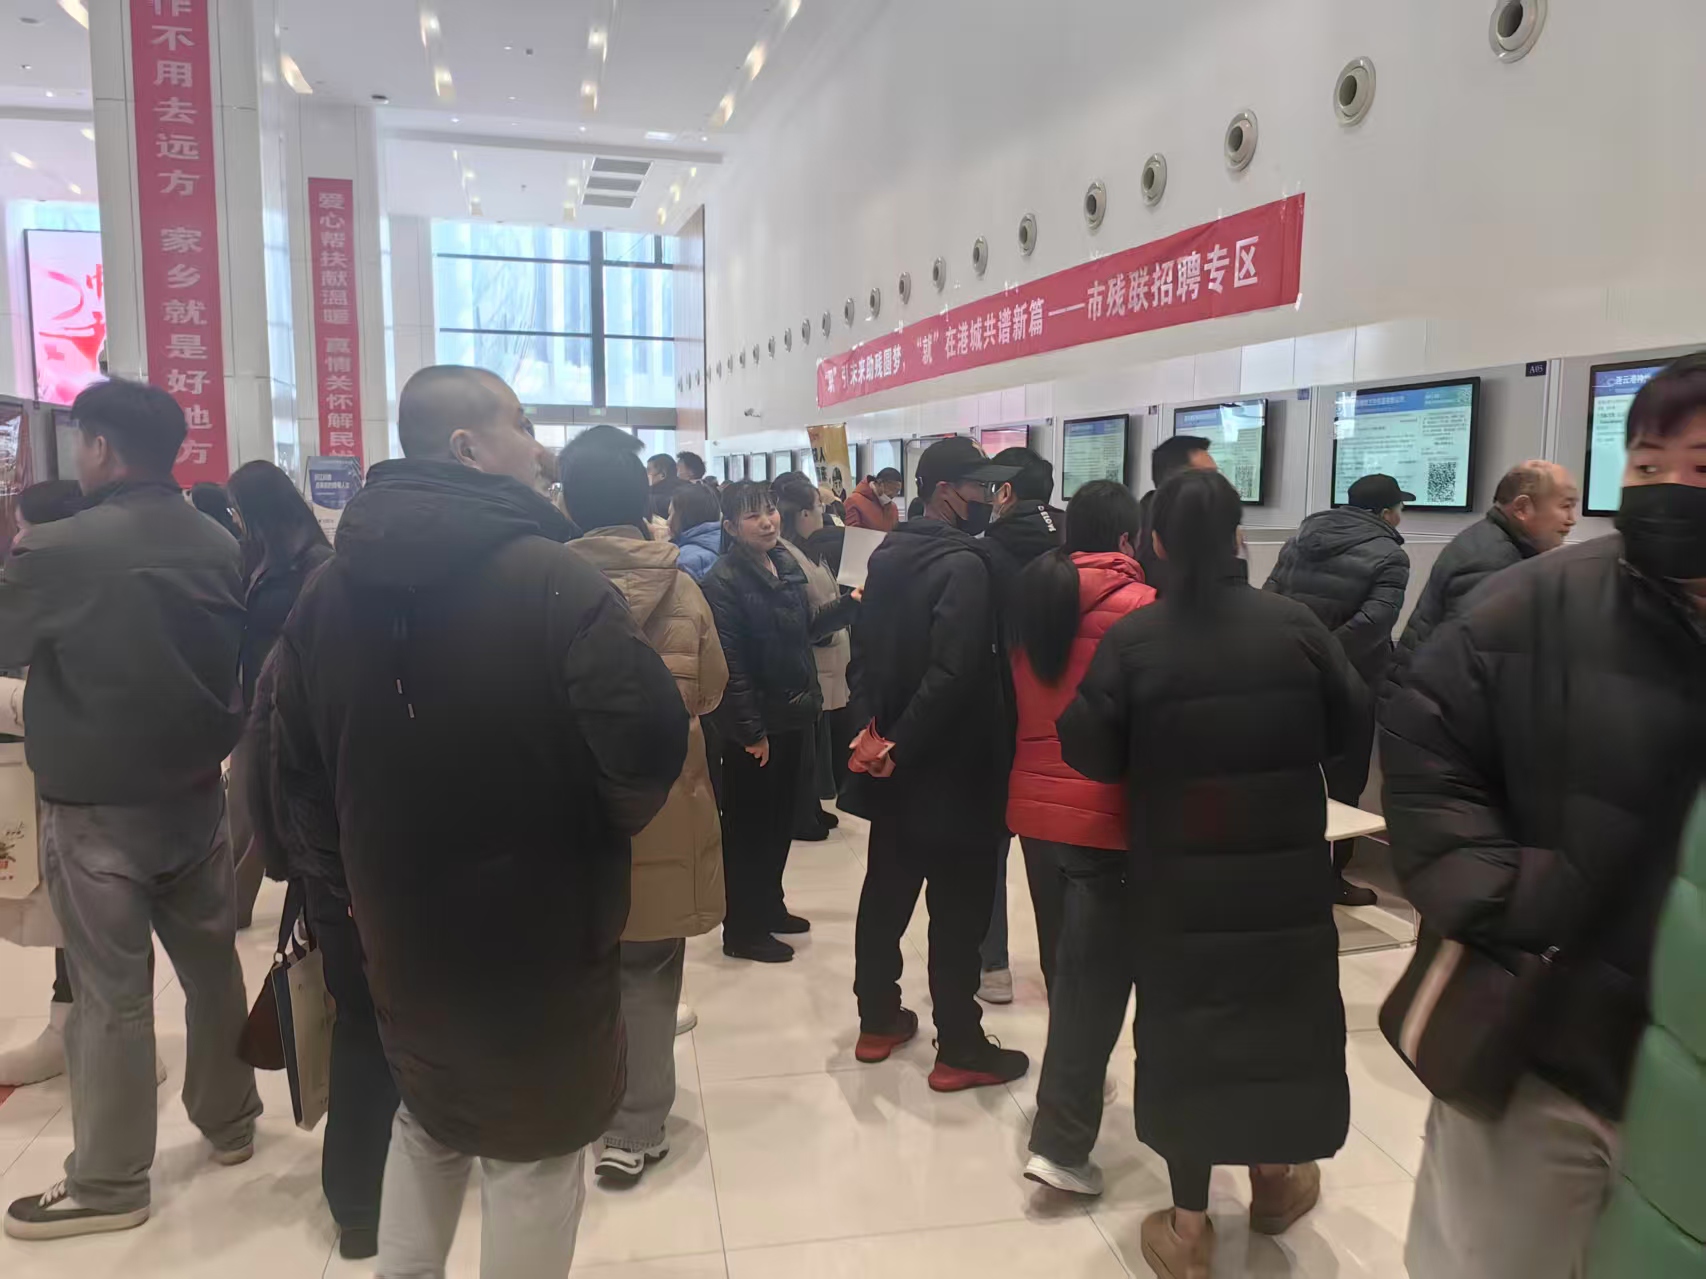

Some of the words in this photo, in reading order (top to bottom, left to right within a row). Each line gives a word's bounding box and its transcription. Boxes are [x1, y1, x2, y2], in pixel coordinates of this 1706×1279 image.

[318, 191, 350, 322] 爱心帮扶献温暖
